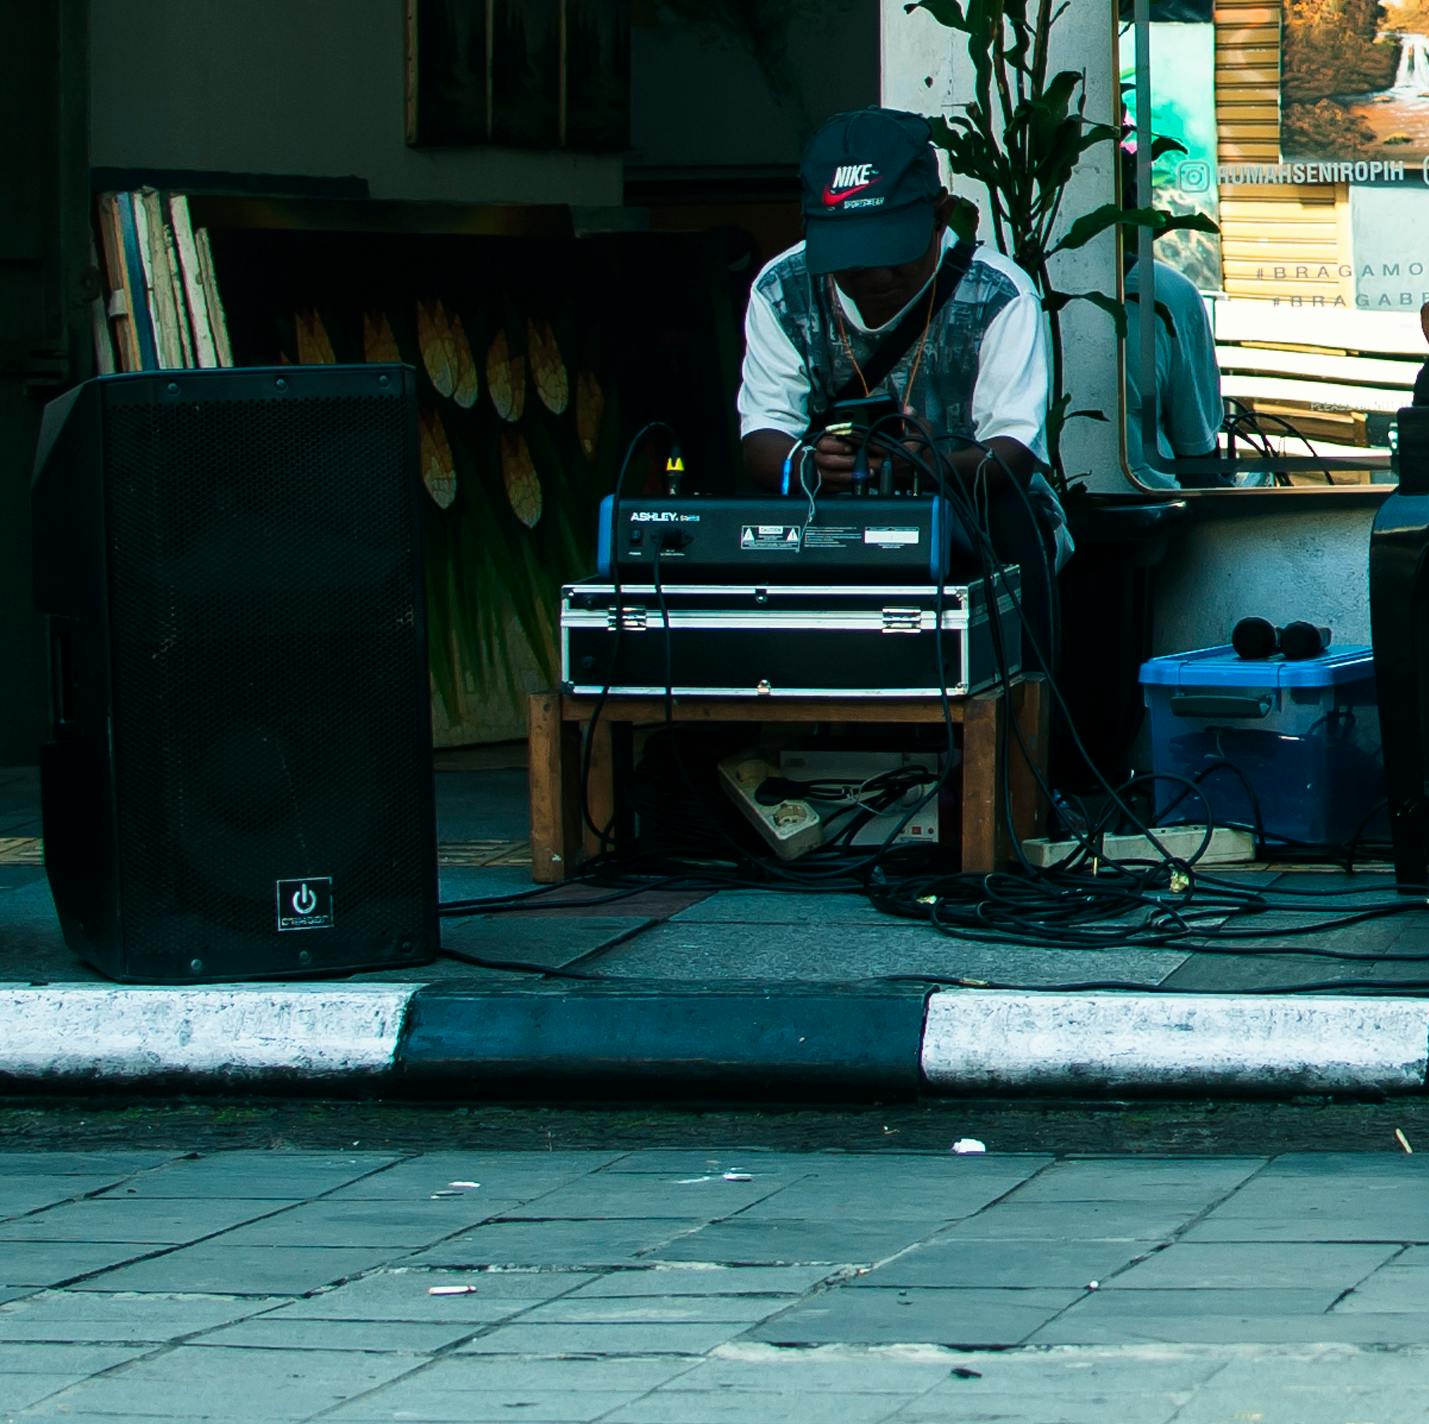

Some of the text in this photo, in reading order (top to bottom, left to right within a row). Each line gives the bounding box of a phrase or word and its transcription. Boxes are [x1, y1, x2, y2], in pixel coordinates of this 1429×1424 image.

[832, 163, 873, 189] NIKE
[1217, 160, 1404, 185] RUMAHSENIROPIH
[630, 512, 677, 522] ASHLEY
